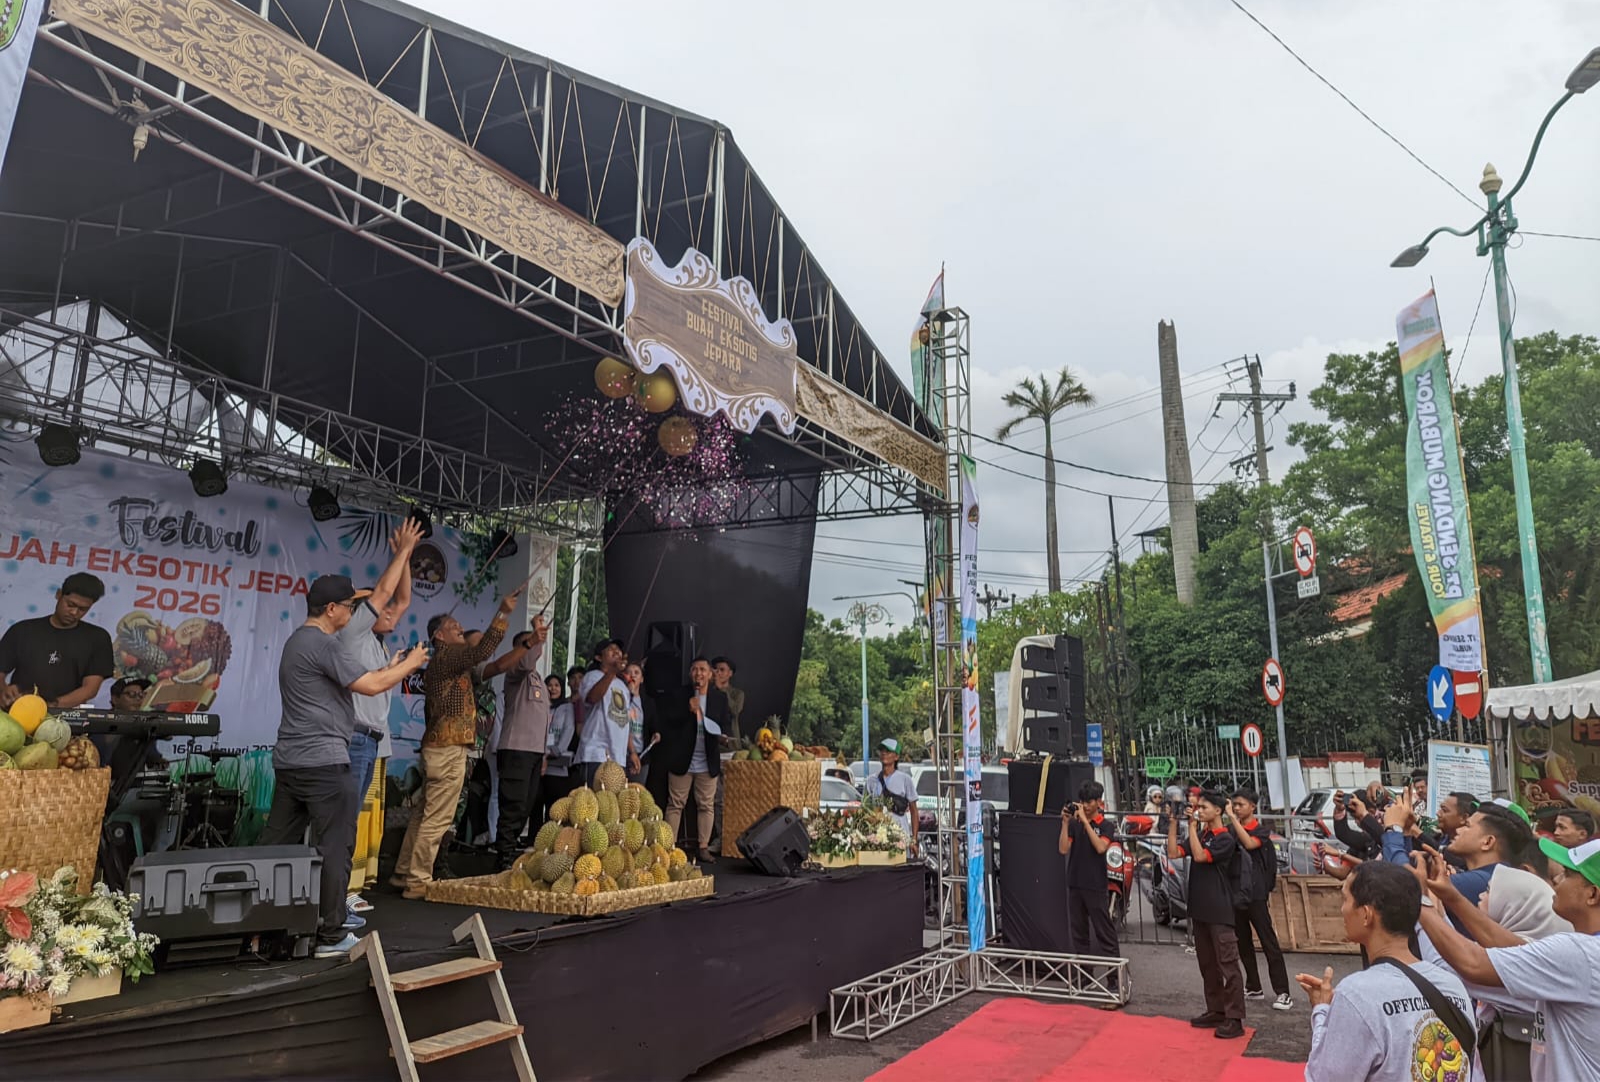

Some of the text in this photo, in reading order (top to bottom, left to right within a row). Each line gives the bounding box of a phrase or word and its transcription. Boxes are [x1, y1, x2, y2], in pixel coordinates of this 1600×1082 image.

[702, 298, 744, 336] FESTIVAL
[686, 310, 758, 363] BUAH EKSOTIS
[703, 342, 741, 374] JEPARA
[108, 496, 261, 556] Festival
[87, 546, 232, 588] EKSOTIK
[133, 585, 221, 616] 2026
[185, 714, 208, 724] KORG
[1383, 996, 1431, 1016] OFFICIA
